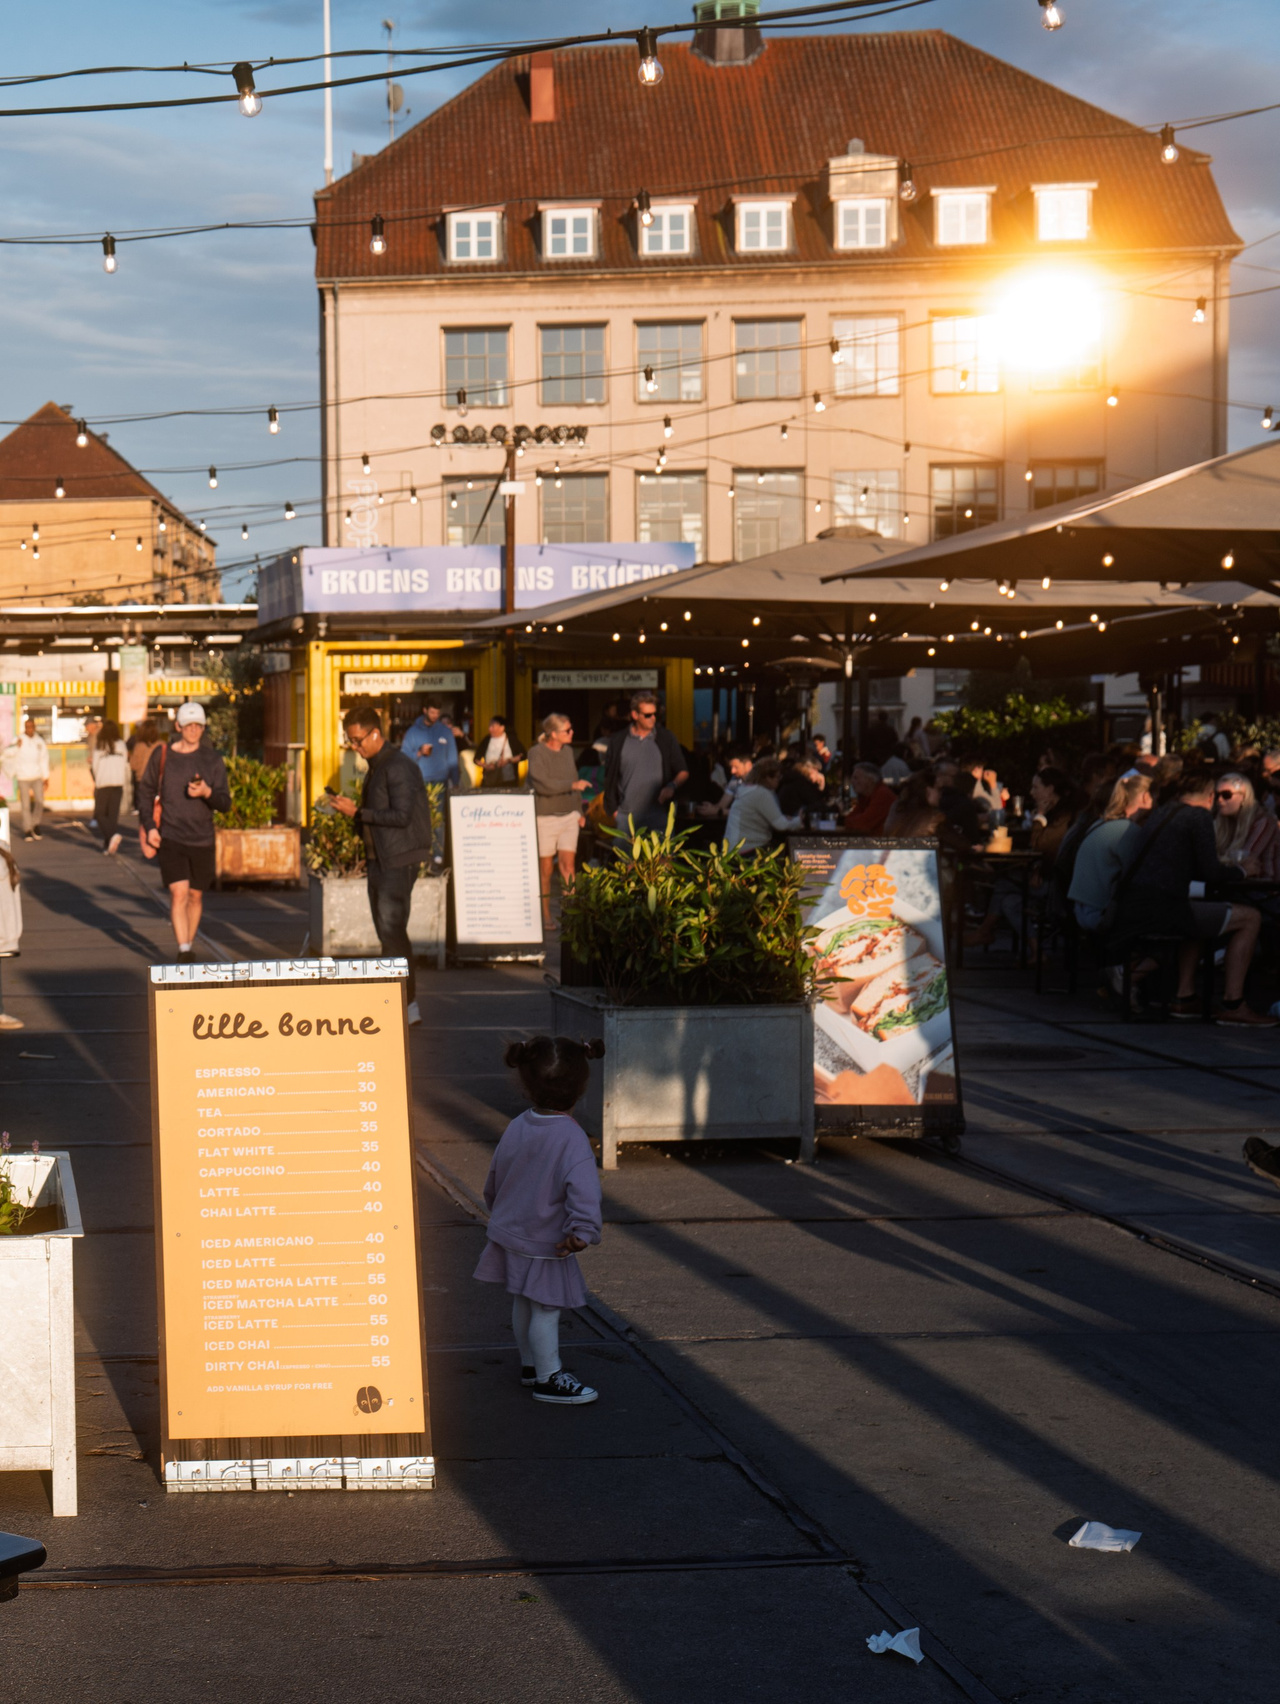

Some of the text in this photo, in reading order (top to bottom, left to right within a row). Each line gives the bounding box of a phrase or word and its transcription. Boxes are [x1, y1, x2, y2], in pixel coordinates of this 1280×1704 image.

[321, 567, 429, 595] BROENS
[446, 567, 554, 593] BRONS
[461, 805, 525, 821] Coffee Corner
[192, 1012, 269, 1041] lille
[195, 1061, 375, 1079] ESPRESSO 25
[196, 1081, 376, 1098] AMERICANO 30
[197, 1101, 377, 1118] TEA 30
[197, 1121, 378, 1138] CORTADO 35
[198, 1141, 379, 1158] FLAT WHITE 35
[199, 1161, 381, 1178] CAPPUCCINO 40
[199, 1181, 382, 1198] LATTE 40
[200, 1201, 383, 1218] CHAI LATTE 40
[201, 1232, 384, 1249] ICED AMERICANO 40
[202, 1253, 385, 1270] ICED LATTE 50
[202, 1273, 386, 1290] ICED MATCHA LATTE 55
[203, 1294, 388, 1310] ICED MATCHA LATTE 60
[203, 1314, 388, 1331] ICED LATTE 55
[204, 1335, 389, 1352] ICED CHAI 50
[205, 1361, 245, 1372] DIRTY
[247, 1360, 280, 1371] CHAI
[371, 1356, 391, 1368] 55
[206, 1382, 333, 1393] ADD VANILLA SYRUP FOR FREE
